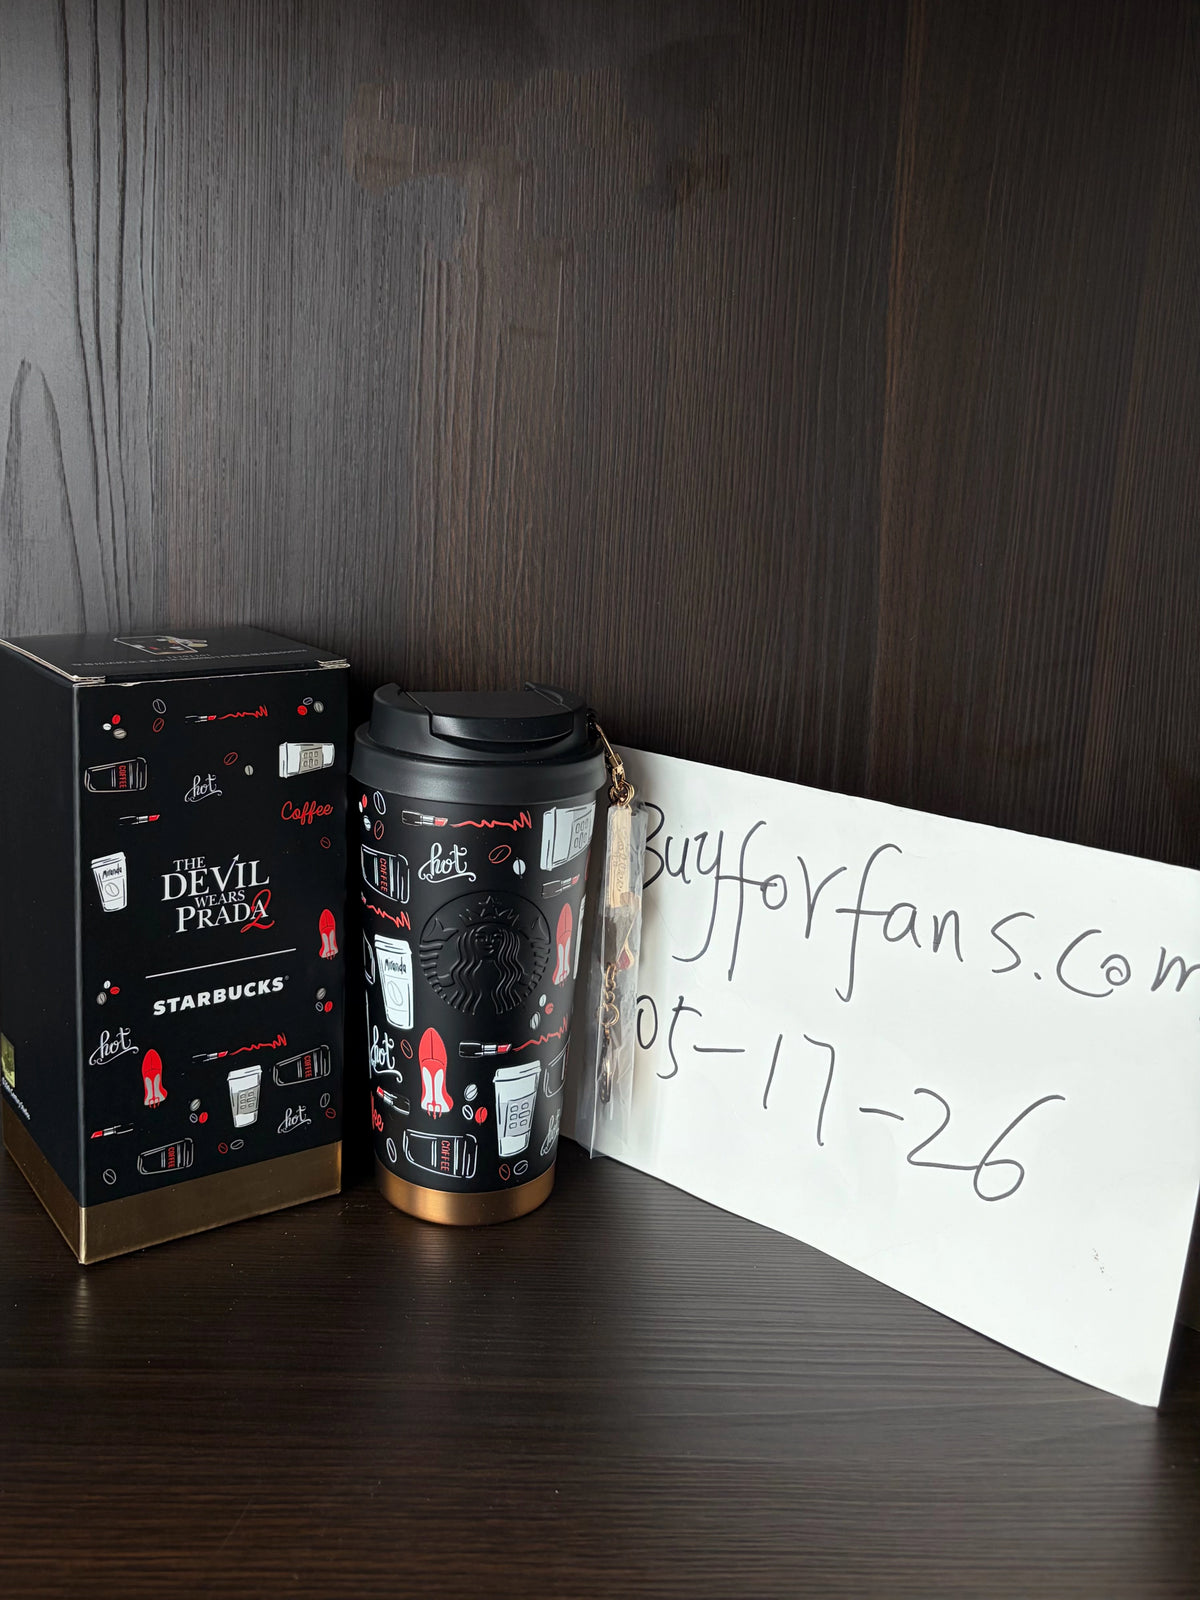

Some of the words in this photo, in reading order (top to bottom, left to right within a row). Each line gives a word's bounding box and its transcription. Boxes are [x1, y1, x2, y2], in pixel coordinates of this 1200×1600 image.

[118, 765, 127, 789] COFFEE
[184, 774, 223, 803] hot
[281, 800, 334, 825] Coffee
[161, 853, 270, 901] DEVIL
[173, 856, 206, 872] THE
[378, 857, 389, 893] COFFEE
[418, 842, 477, 884] hot
[175, 898, 269, 934] PRADA
[240, 888, 276, 934] 2
[195, 889, 246, 908] WEARS
[383, 957, 408, 974] Miranda
[153, 976, 284, 1016] STARBUCKS
[89, 1027, 139, 1066] hot
[303, 1054, 312, 1079] COFFEE
[636, 995, 1066, 1202] 05-17-26
[277, 1105, 312, 1134] hot
[167, 1146, 176, 1169] COFFEE
[440, 1140, 451, 1173] COFFEE
